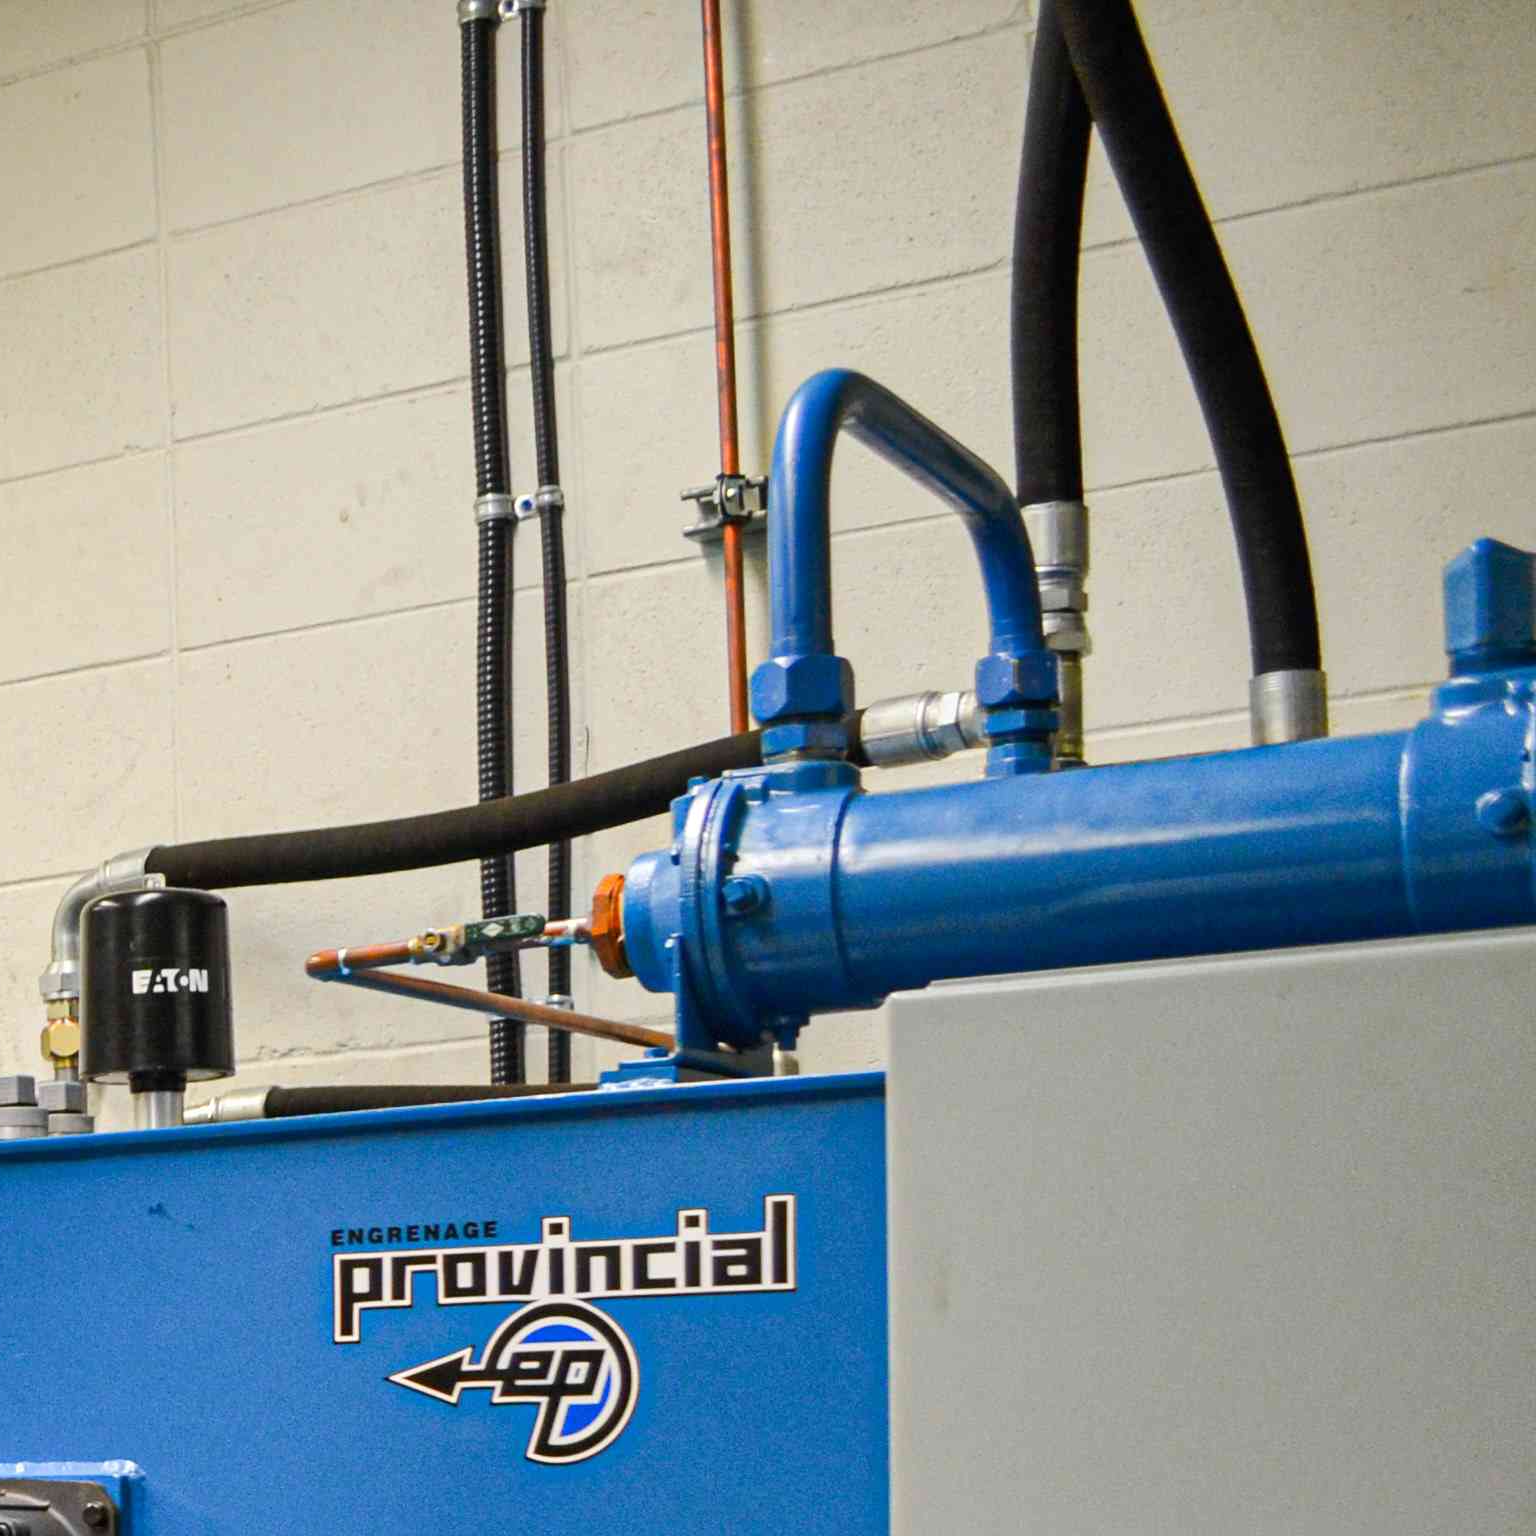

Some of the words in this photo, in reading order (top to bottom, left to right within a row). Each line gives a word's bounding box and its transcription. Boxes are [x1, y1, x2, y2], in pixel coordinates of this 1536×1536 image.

[132, 968, 208, 994] EATON
[330, 1220, 499, 1247] ENGRENAGE
[334, 1196, 795, 1342] provincial
